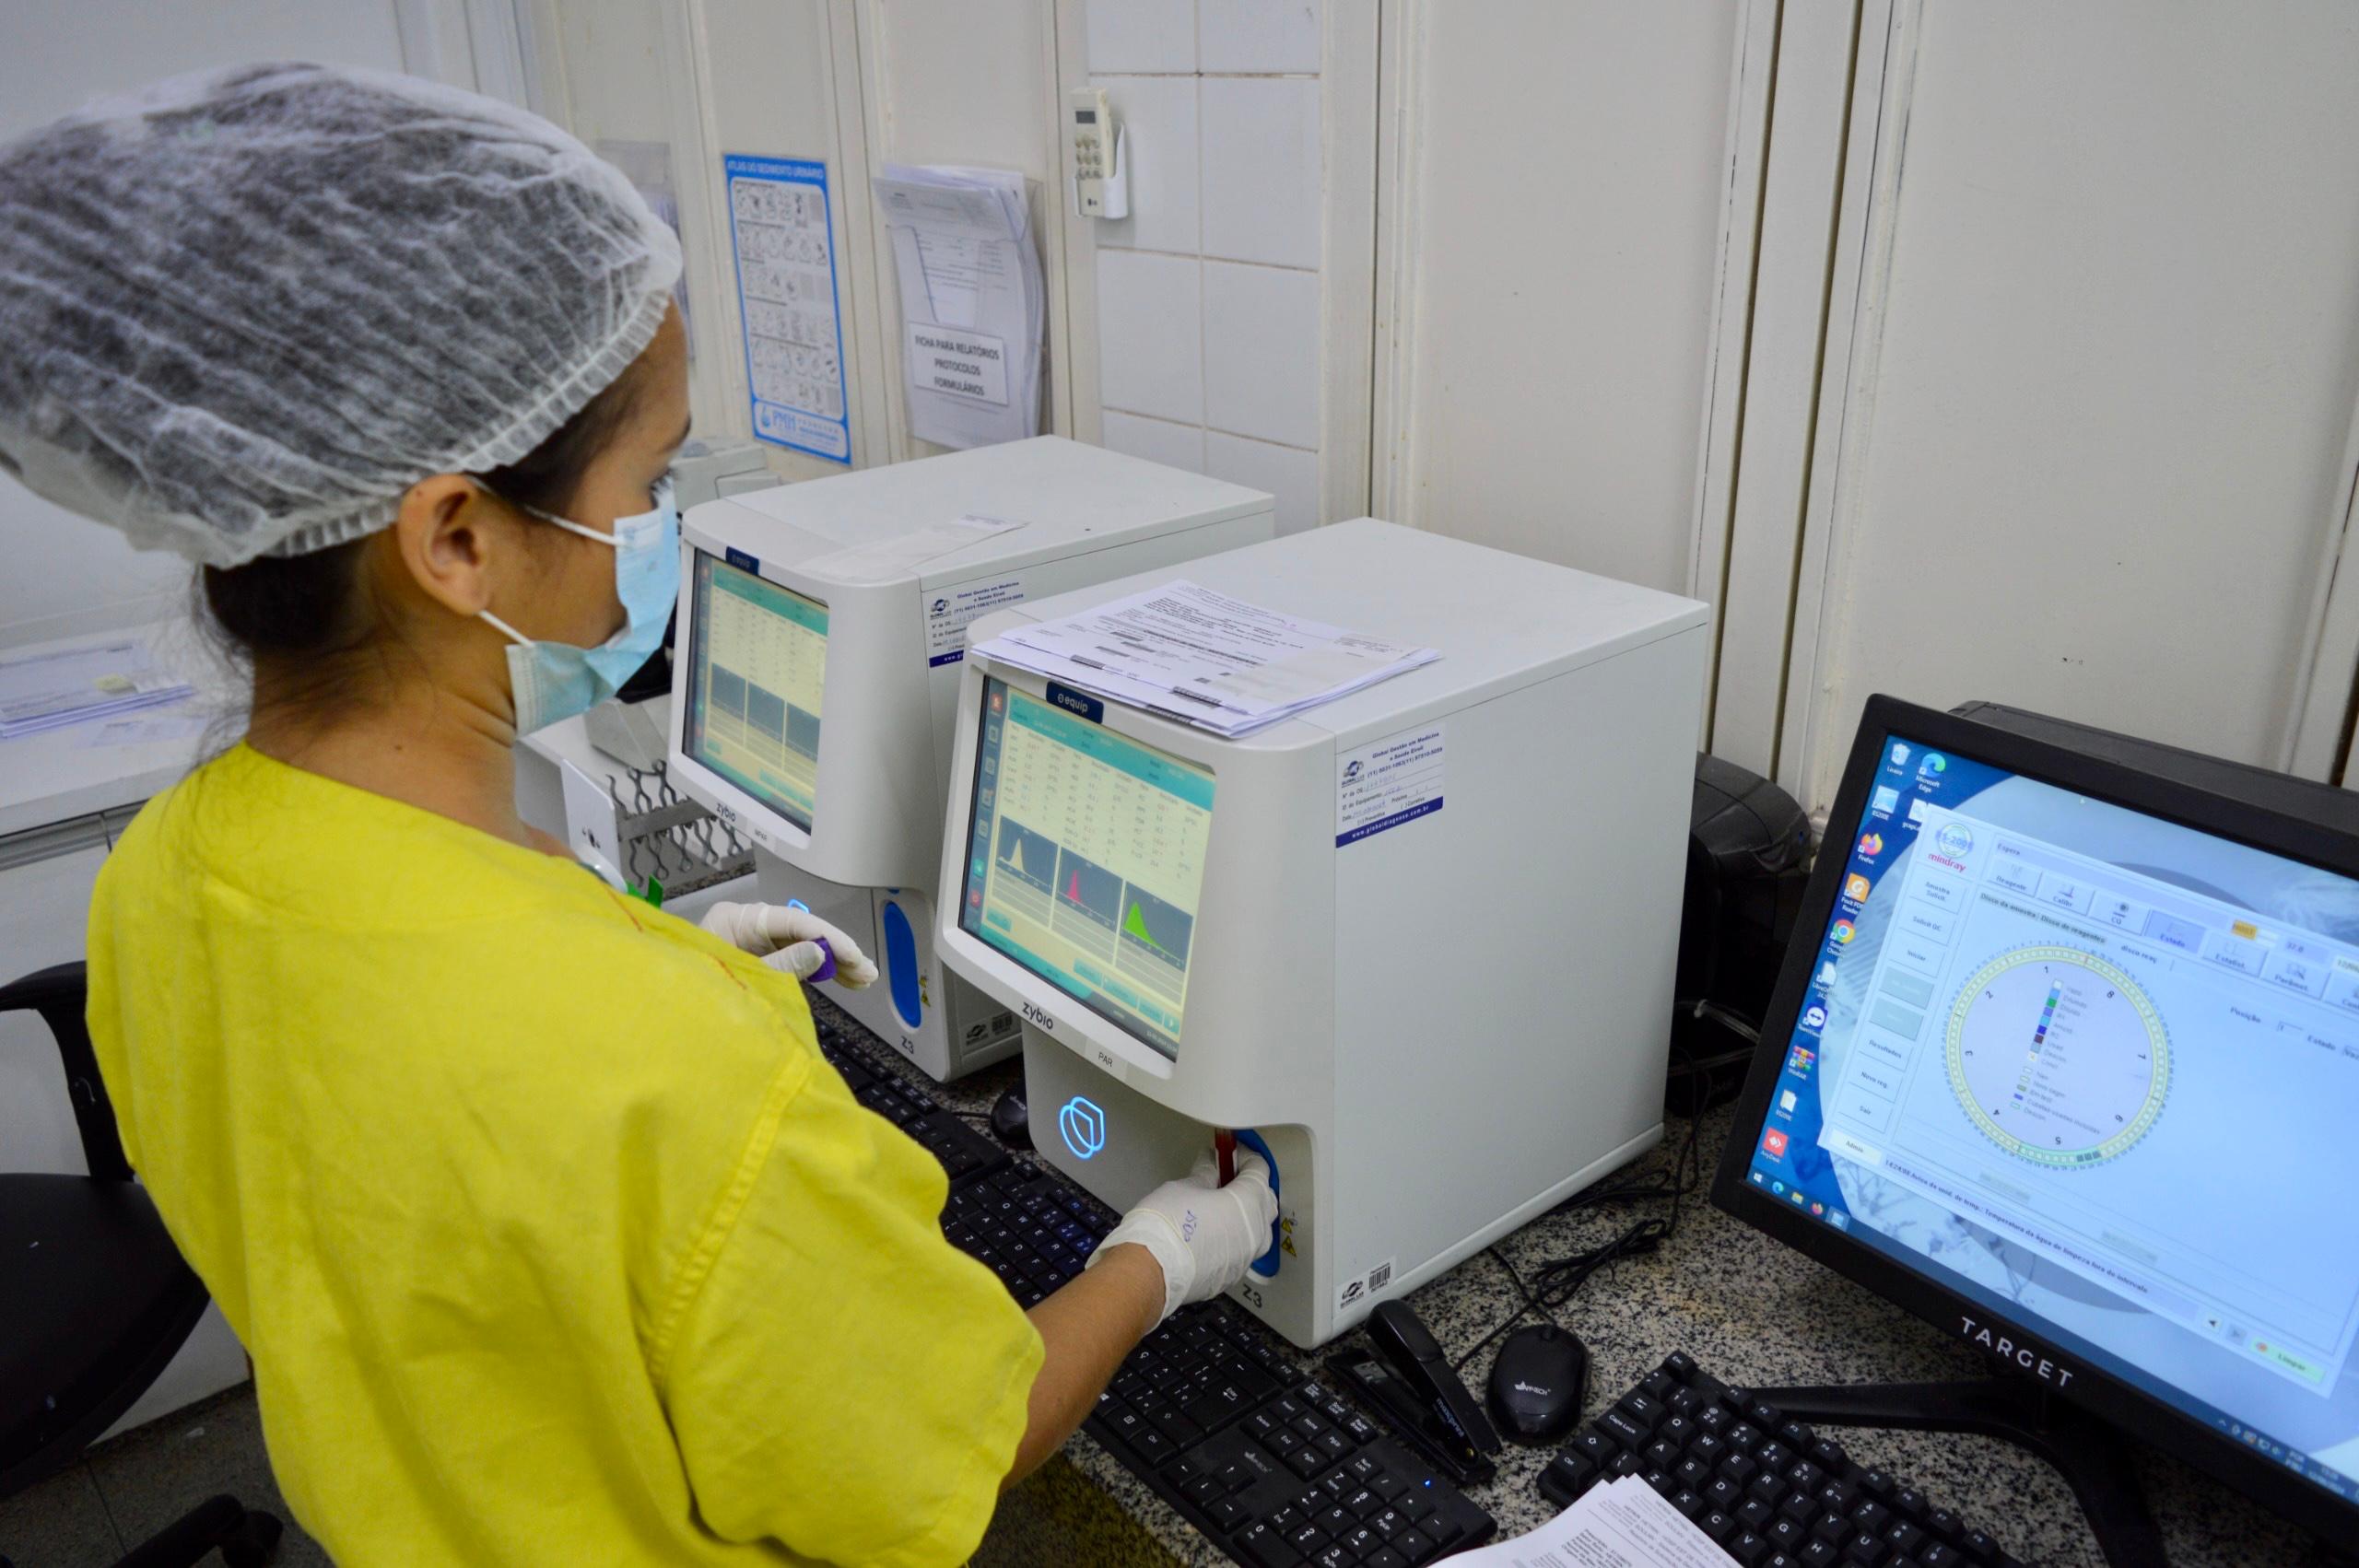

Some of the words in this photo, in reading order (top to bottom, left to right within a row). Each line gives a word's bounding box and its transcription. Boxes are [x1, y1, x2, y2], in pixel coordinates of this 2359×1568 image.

[915, 335, 934, 347] FICHA
[936, 339, 954, 351] PARA
[957, 343, 999, 360] RELATÓRIOS
[934, 357, 980, 376] PROTOCOLOS
[934, 376, 984, 396] FORMULÁRIOS
[1065, 696, 1087, 713] equip
[1916, 775, 1941, 789] Microsoft
[1919, 783, 1931, 793] Edge
[1997, 843, 2020, 856] Espera
[1858, 855, 1874, 865] Firefox
[1928, 853, 1966, 872] mindray
[1996, 876, 2026, 891] Reagente
[1980, 892, 2000, 905] Disco
[2000, 900, 2009, 908] da
[2010, 904, 2036, 919] amostra
[2040, 914, 2060, 927] Disco
[2061, 923, 2071, 931] de
[2071, 927, 2106, 943] reagentes
[2160, 933, 2186, 948] Estado
[2121, 944, 2141, 957] disco
[2044, 965, 2048, 974] 1
[1986, 990, 1993, 999] 2
[2107, 990, 2115, 999] 8
[1022, 1002, 1053, 1030] zybio
[901, 1036, 914, 1055] Z3
[2306, 1035, 2337, 1051] Estado
[1098, 1052, 1113, 1068] PAR
[1860, 1106, 1872, 1115] Sair
[2055, 1136, 2061, 1145] 5
[1954, 1194, 1963, 1202] de
[1985, 1208, 2025, 1233] Temperatura
[2025, 1228, 2035, 1237] da
[2036, 1231, 2053, 1247] água
[2053, 1242, 2062, 1251] de
[2062, 1246, 2091, 1266] limpeza
[2091, 1260, 2107, 1273] fora
[1243, 1283, 1262, 1308] Z3
[1962, 1316, 2073, 1387] TARGET
[2278, 1352, 2306, 1372] Limpar
[1609, 1414, 1623, 1426] Caps
[1623, 1422, 1637, 1434] Lock
[1672, 1418, 1682, 1427] Q
[1702, 1436, 1714, 1446] W
[1656, 1444, 1665, 1452] A
[1731, 1455, 1741, 1465] E
[1685, 1462, 1695, 1470] S
[1649, 1474, 1660, 1482] Z
[1762, 1475, 1772, 1484] R
[1716, 1481, 1726, 1491] D
[1358, 1492, 1368, 1500] 8
[1680, 1493, 1691, 1503] X
[1794, 1495, 1804, 1504] T
[1747, 1502, 1757, 1510] F
[1385, 1512, 1394, 1520] 9
[1711, 1515, 1721, 1524] C
[1827, 1515, 1837, 1524] Y
[1778, 1523, 1789, 1533] G
[1358, 1530, 1367, 1539] 6
[1743, 1536, 1754, 1544] V
[1860, 1537, 1871, 1546] U
[1811, 1543, 1823, 1553] H
[1332, 1550, 1341, 1558] 3
[1774, 1556, 1784, 1565] B
